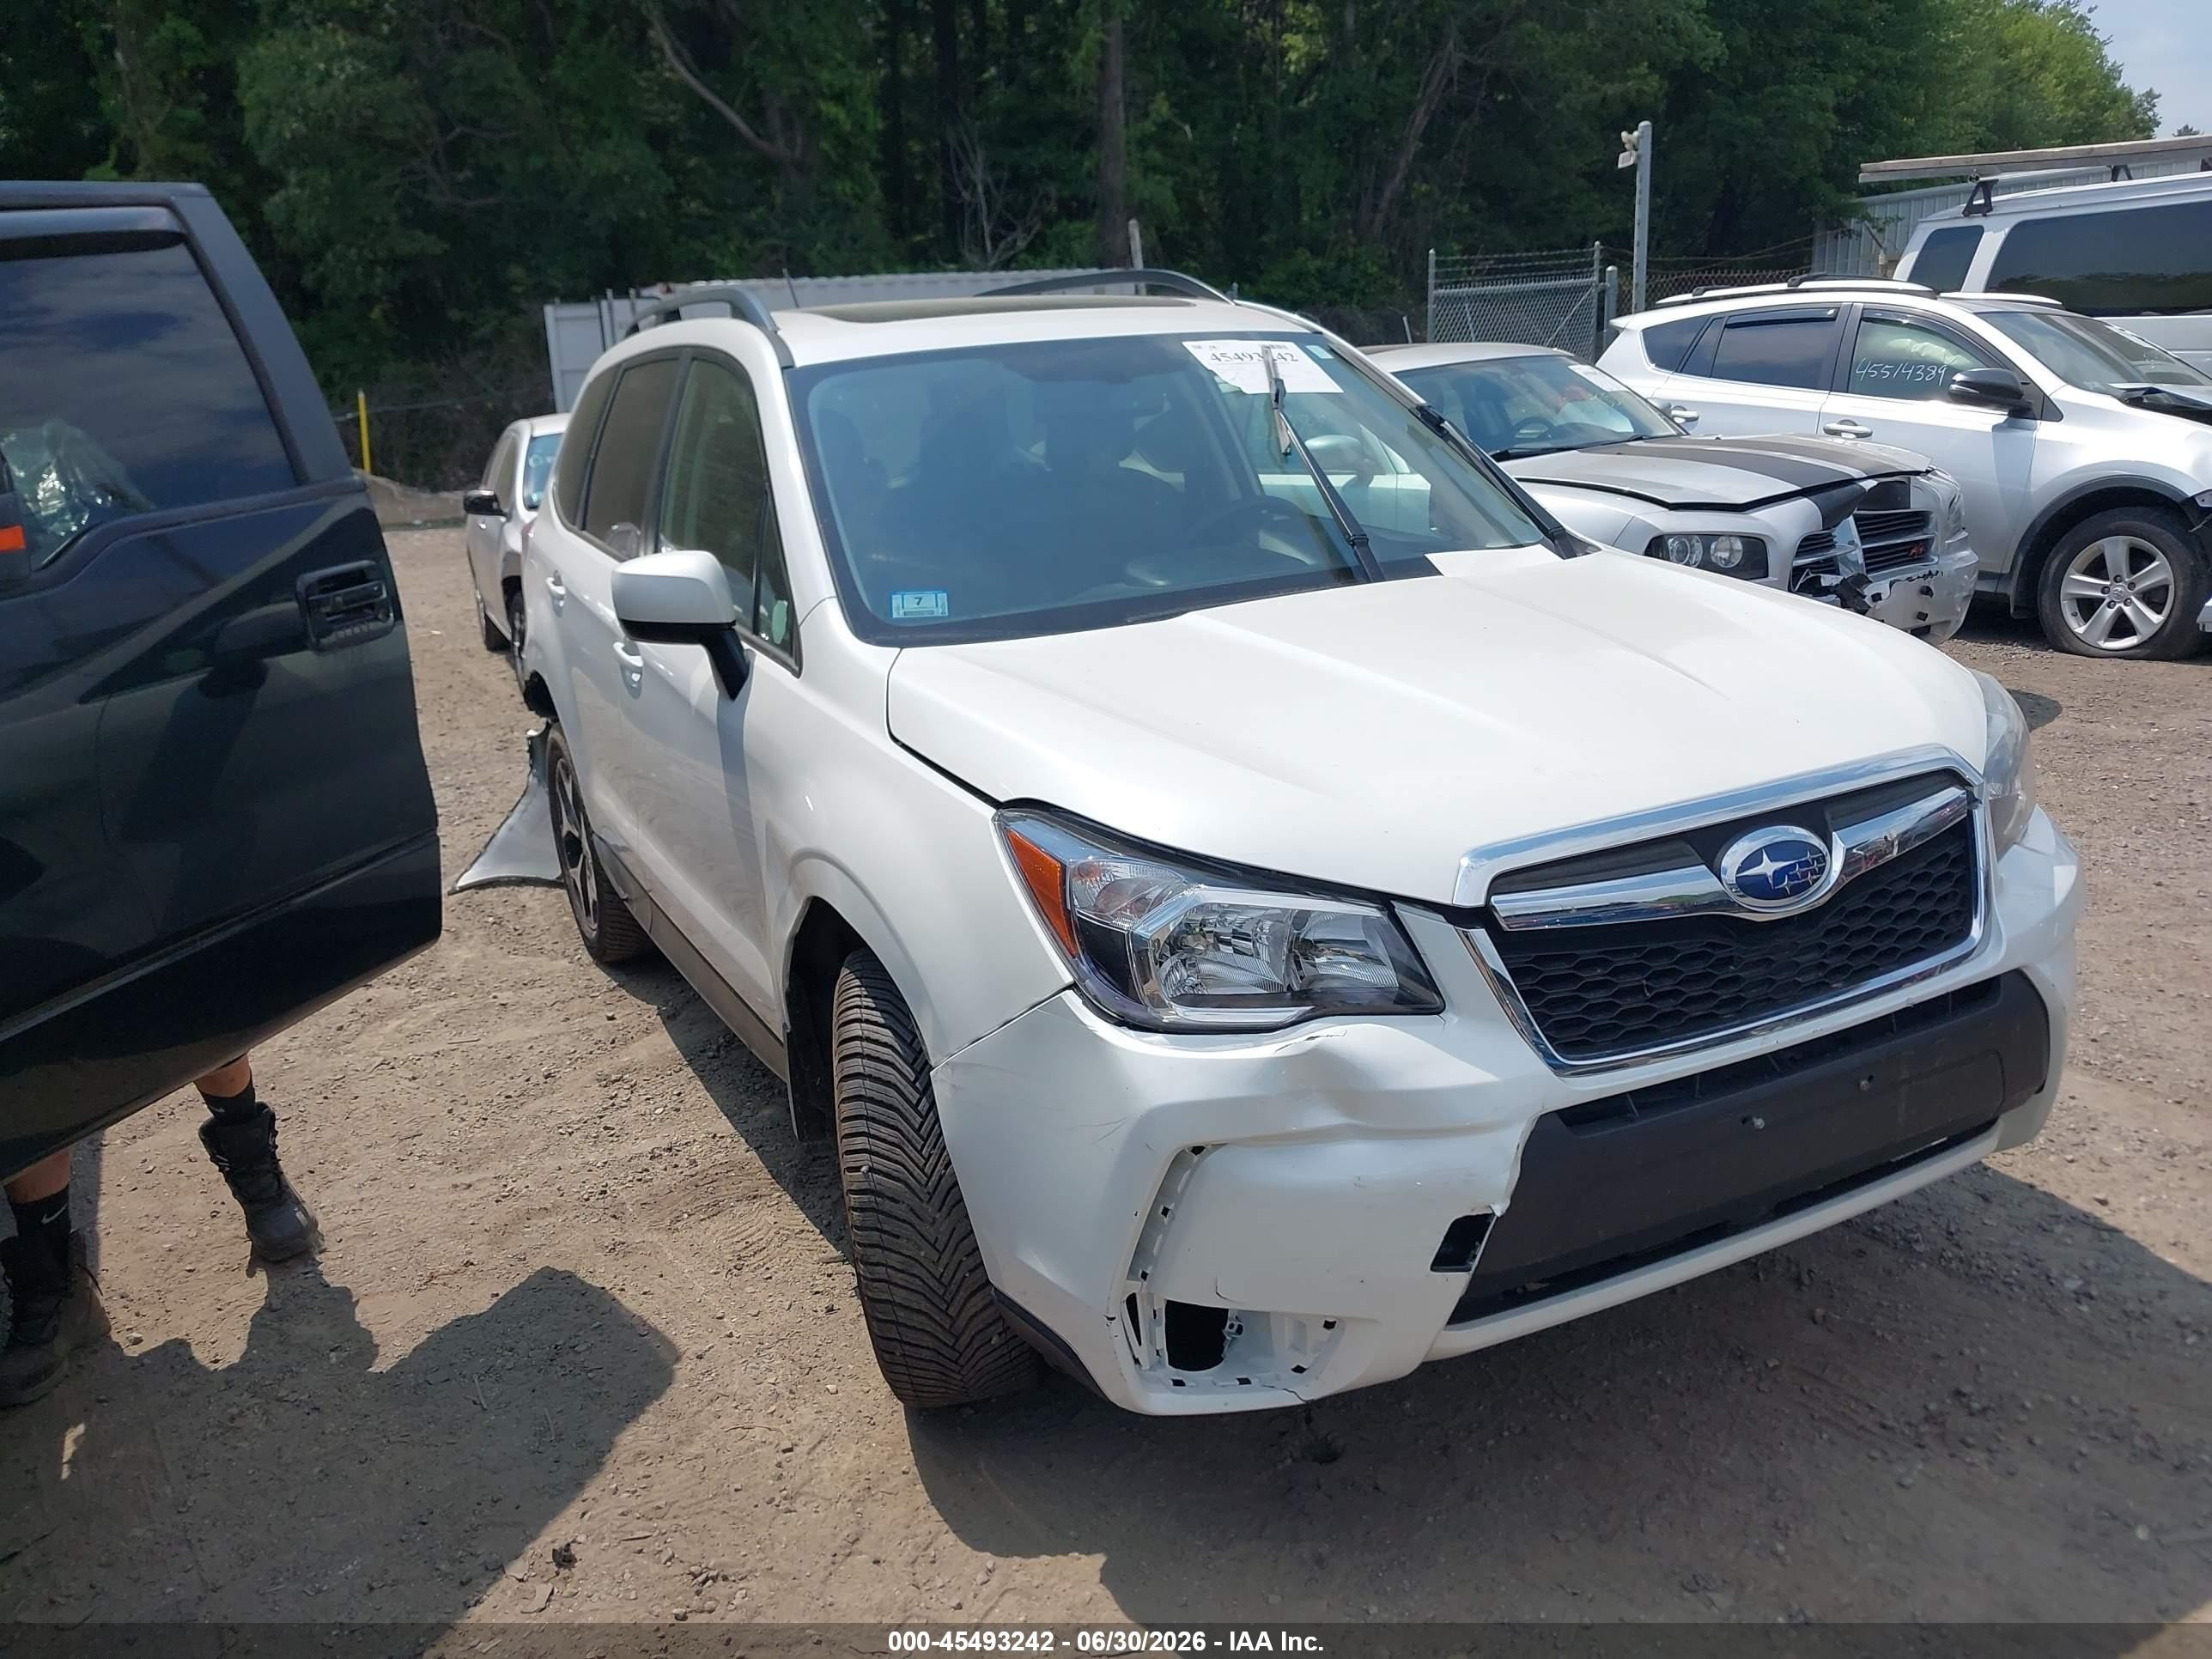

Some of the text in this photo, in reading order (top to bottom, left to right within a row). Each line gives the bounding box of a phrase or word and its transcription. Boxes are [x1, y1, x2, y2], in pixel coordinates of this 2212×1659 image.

[1210, 352, 1298, 362] 4549342
[1856, 358, 1948, 386] 45514389
[914, 597, 923, 606] 7
